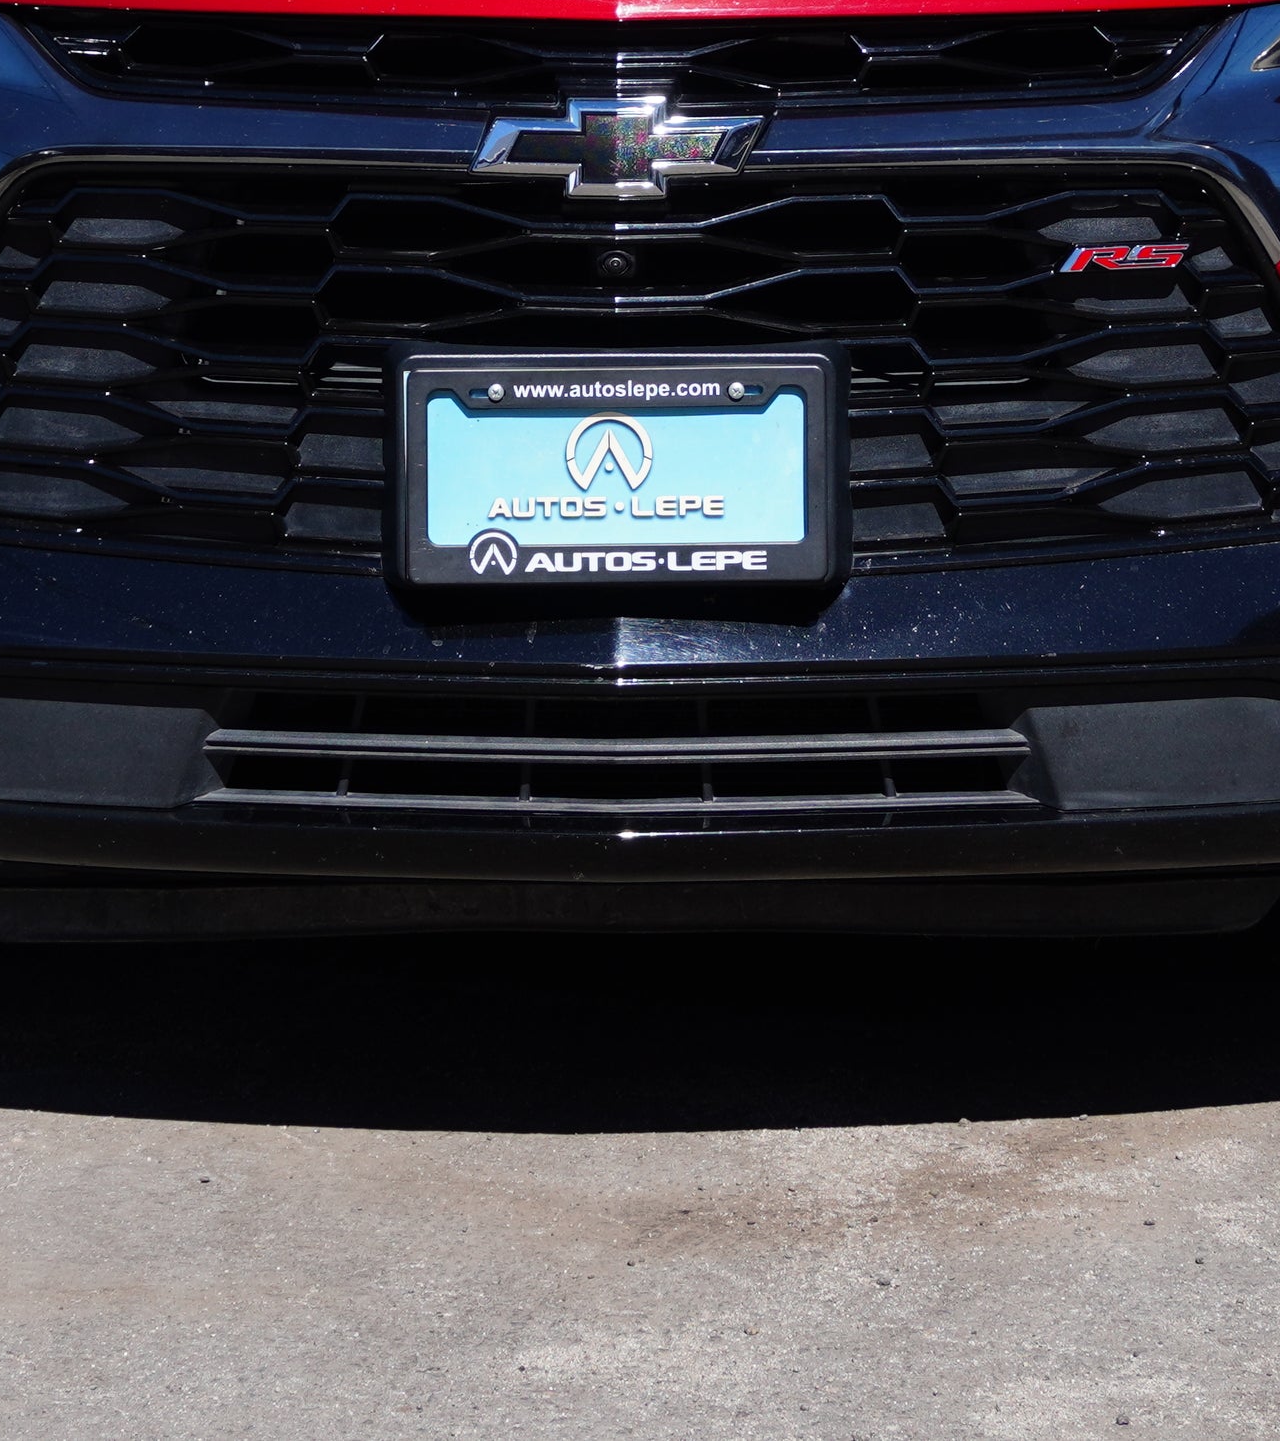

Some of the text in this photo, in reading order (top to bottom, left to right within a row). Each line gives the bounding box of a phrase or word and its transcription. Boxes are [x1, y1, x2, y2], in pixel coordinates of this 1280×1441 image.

[1059, 243, 1190, 273] RS
[513, 380, 721, 402] www.autoslepe.com
[487, 495, 725, 519] AUTOS LEPE
